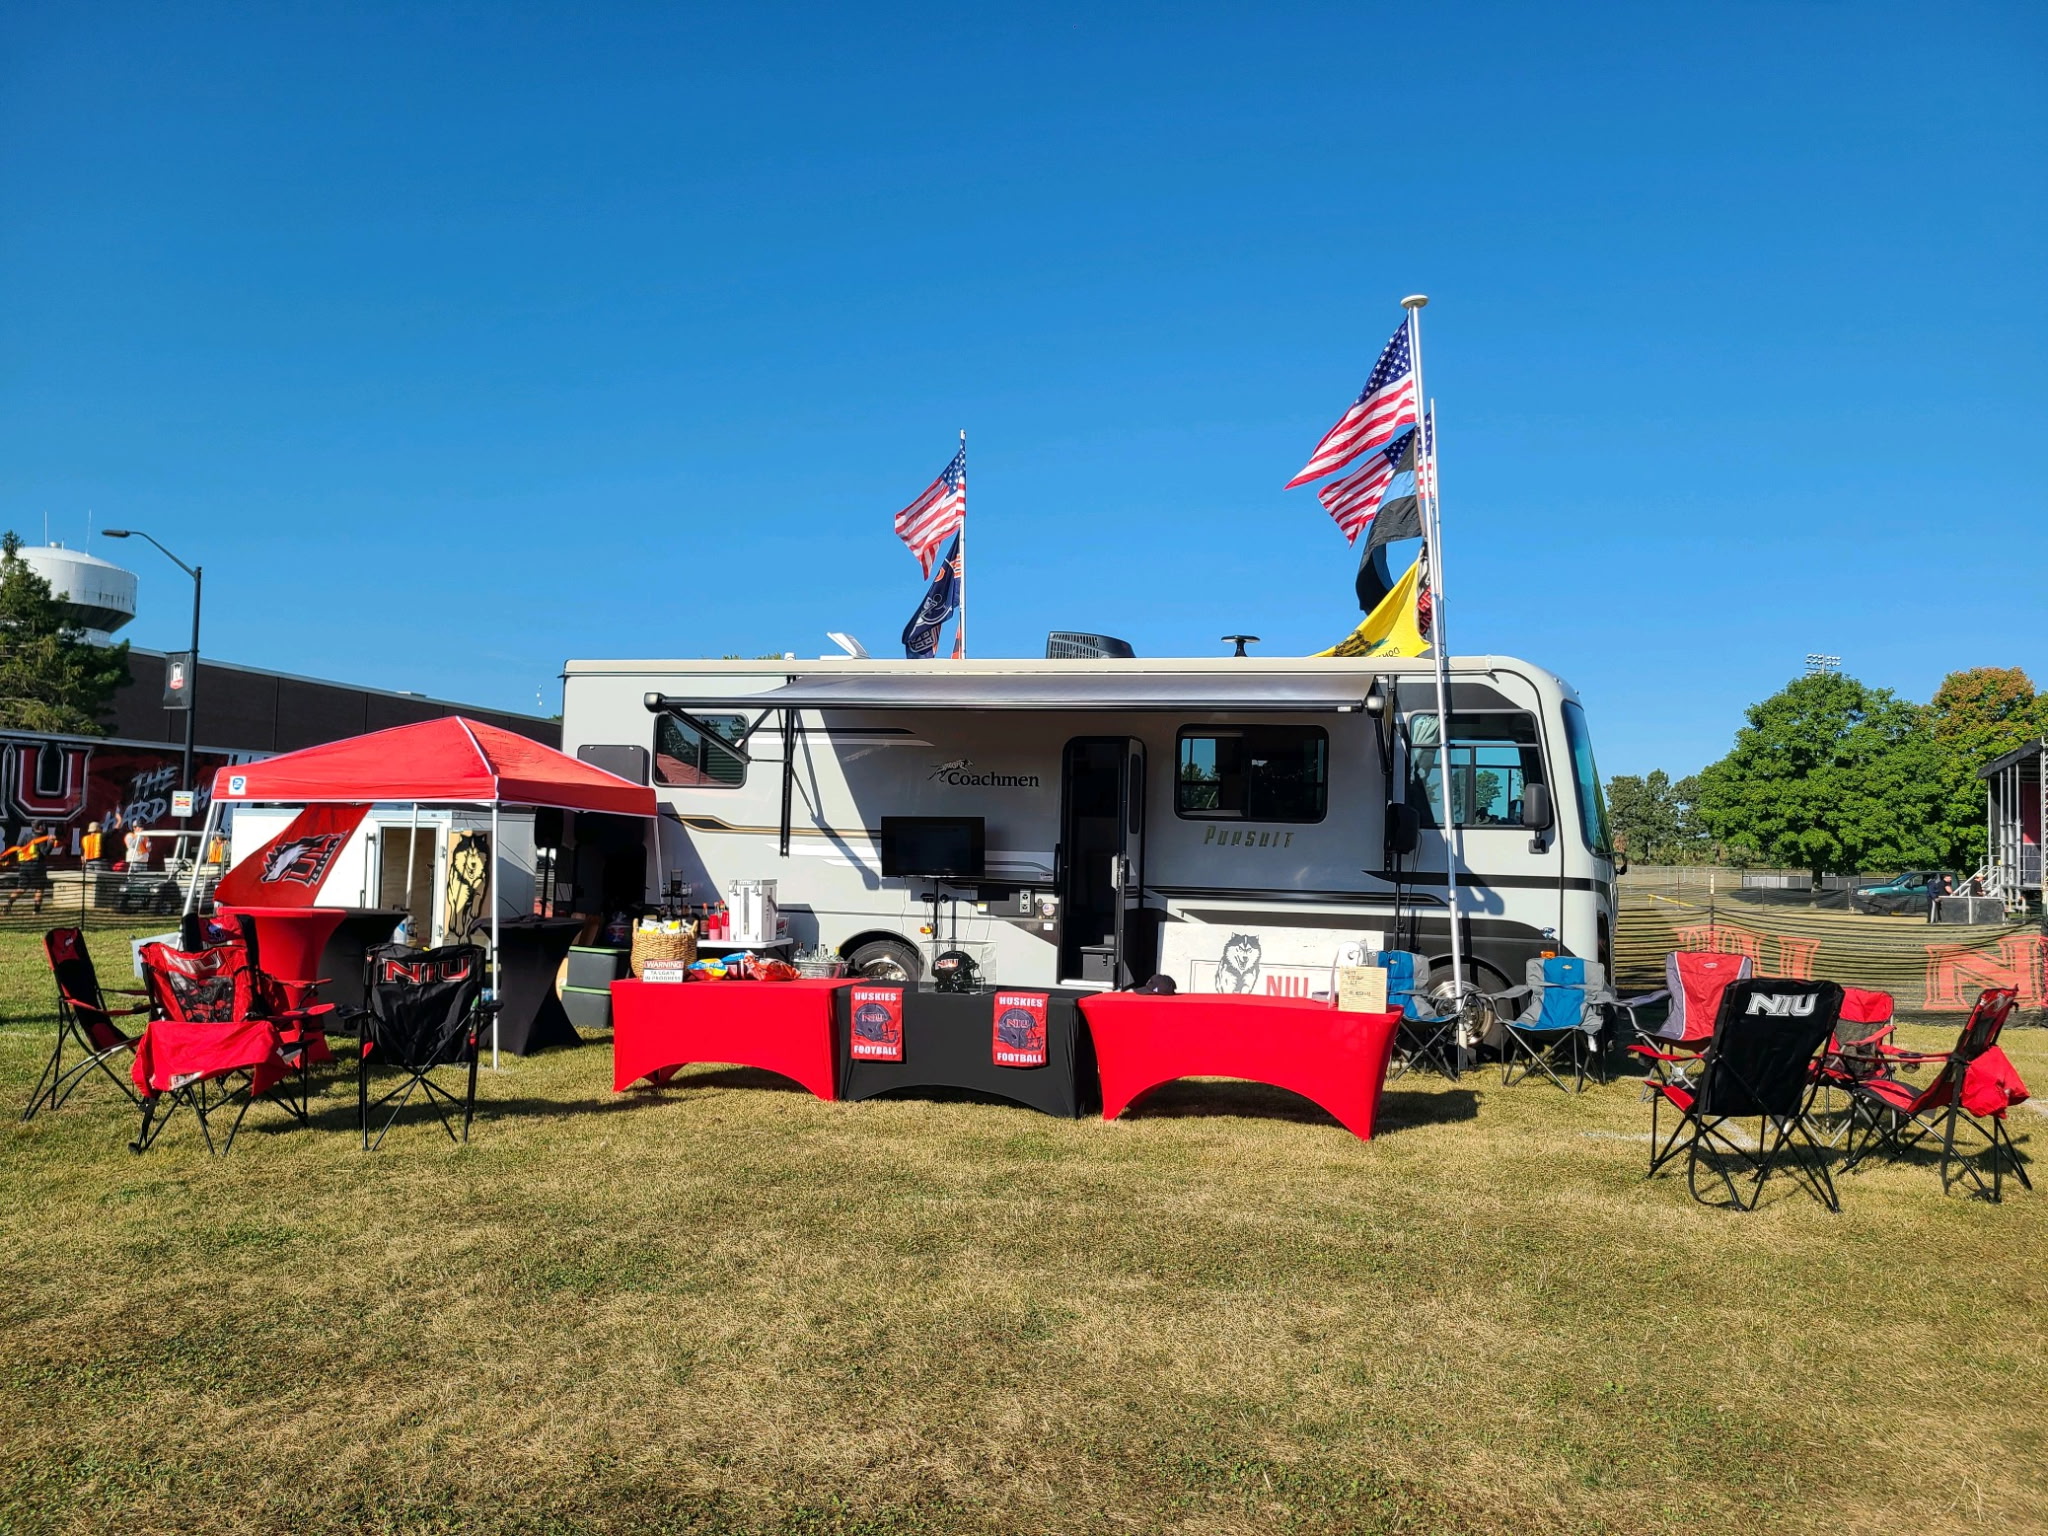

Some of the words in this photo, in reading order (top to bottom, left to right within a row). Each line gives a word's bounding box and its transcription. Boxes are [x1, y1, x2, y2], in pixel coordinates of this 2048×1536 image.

[131, 766, 179, 800] THE
[948, 771, 1040, 787] Coachmen
[101, 798, 168, 833] HARD
[380, 955, 472, 985] NIU
[646, 961, 682, 969] WARNING
[1266, 975, 1309, 999] NIU
[854, 992, 897, 1001] HUSKIES
[999, 996, 1043, 1008] HUSKIES
[1745, 992, 1819, 1016] NIU
[861, 1012, 885, 1023] NIU
[1006, 1018, 1031, 1029] NIU
[853, 1045, 897, 1055] FOOTBALL
[997, 1052, 1043, 1063] FOOTBALL
